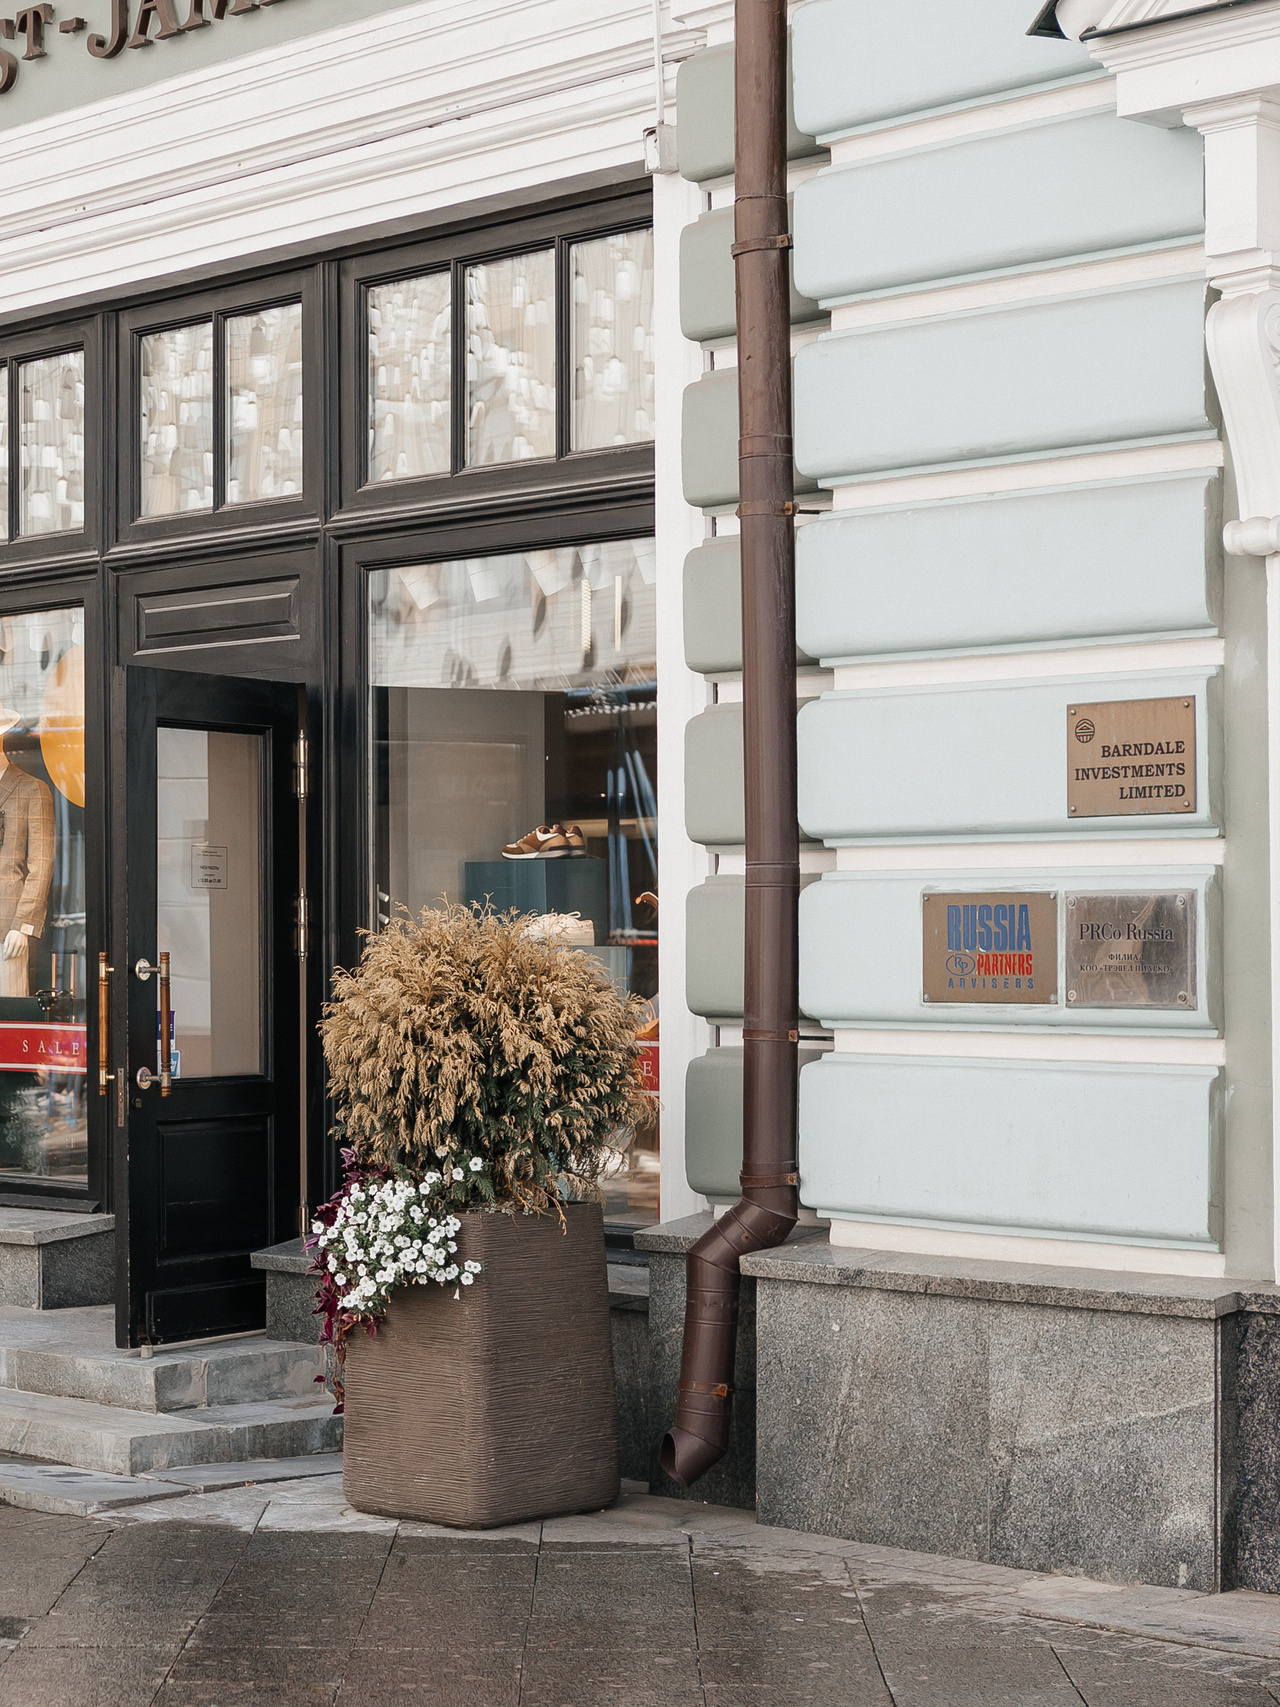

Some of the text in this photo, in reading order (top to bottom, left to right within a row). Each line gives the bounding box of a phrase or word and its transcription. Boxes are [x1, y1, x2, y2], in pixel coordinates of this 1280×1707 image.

[1101, 741, 1185, 758] BARNDALE
[1075, 763, 1185, 781] INVESTMENTS
[1119, 784, 1186, 800] LIMITED
[947, 904, 1032, 952] RUSSIA
[1079, 922, 1173, 940] PRCo Russia
[977, 953, 1033, 976] PARTNERS
[948, 978, 1034, 989] ADVISERS
[22, 1040, 80, 1055] SALE
